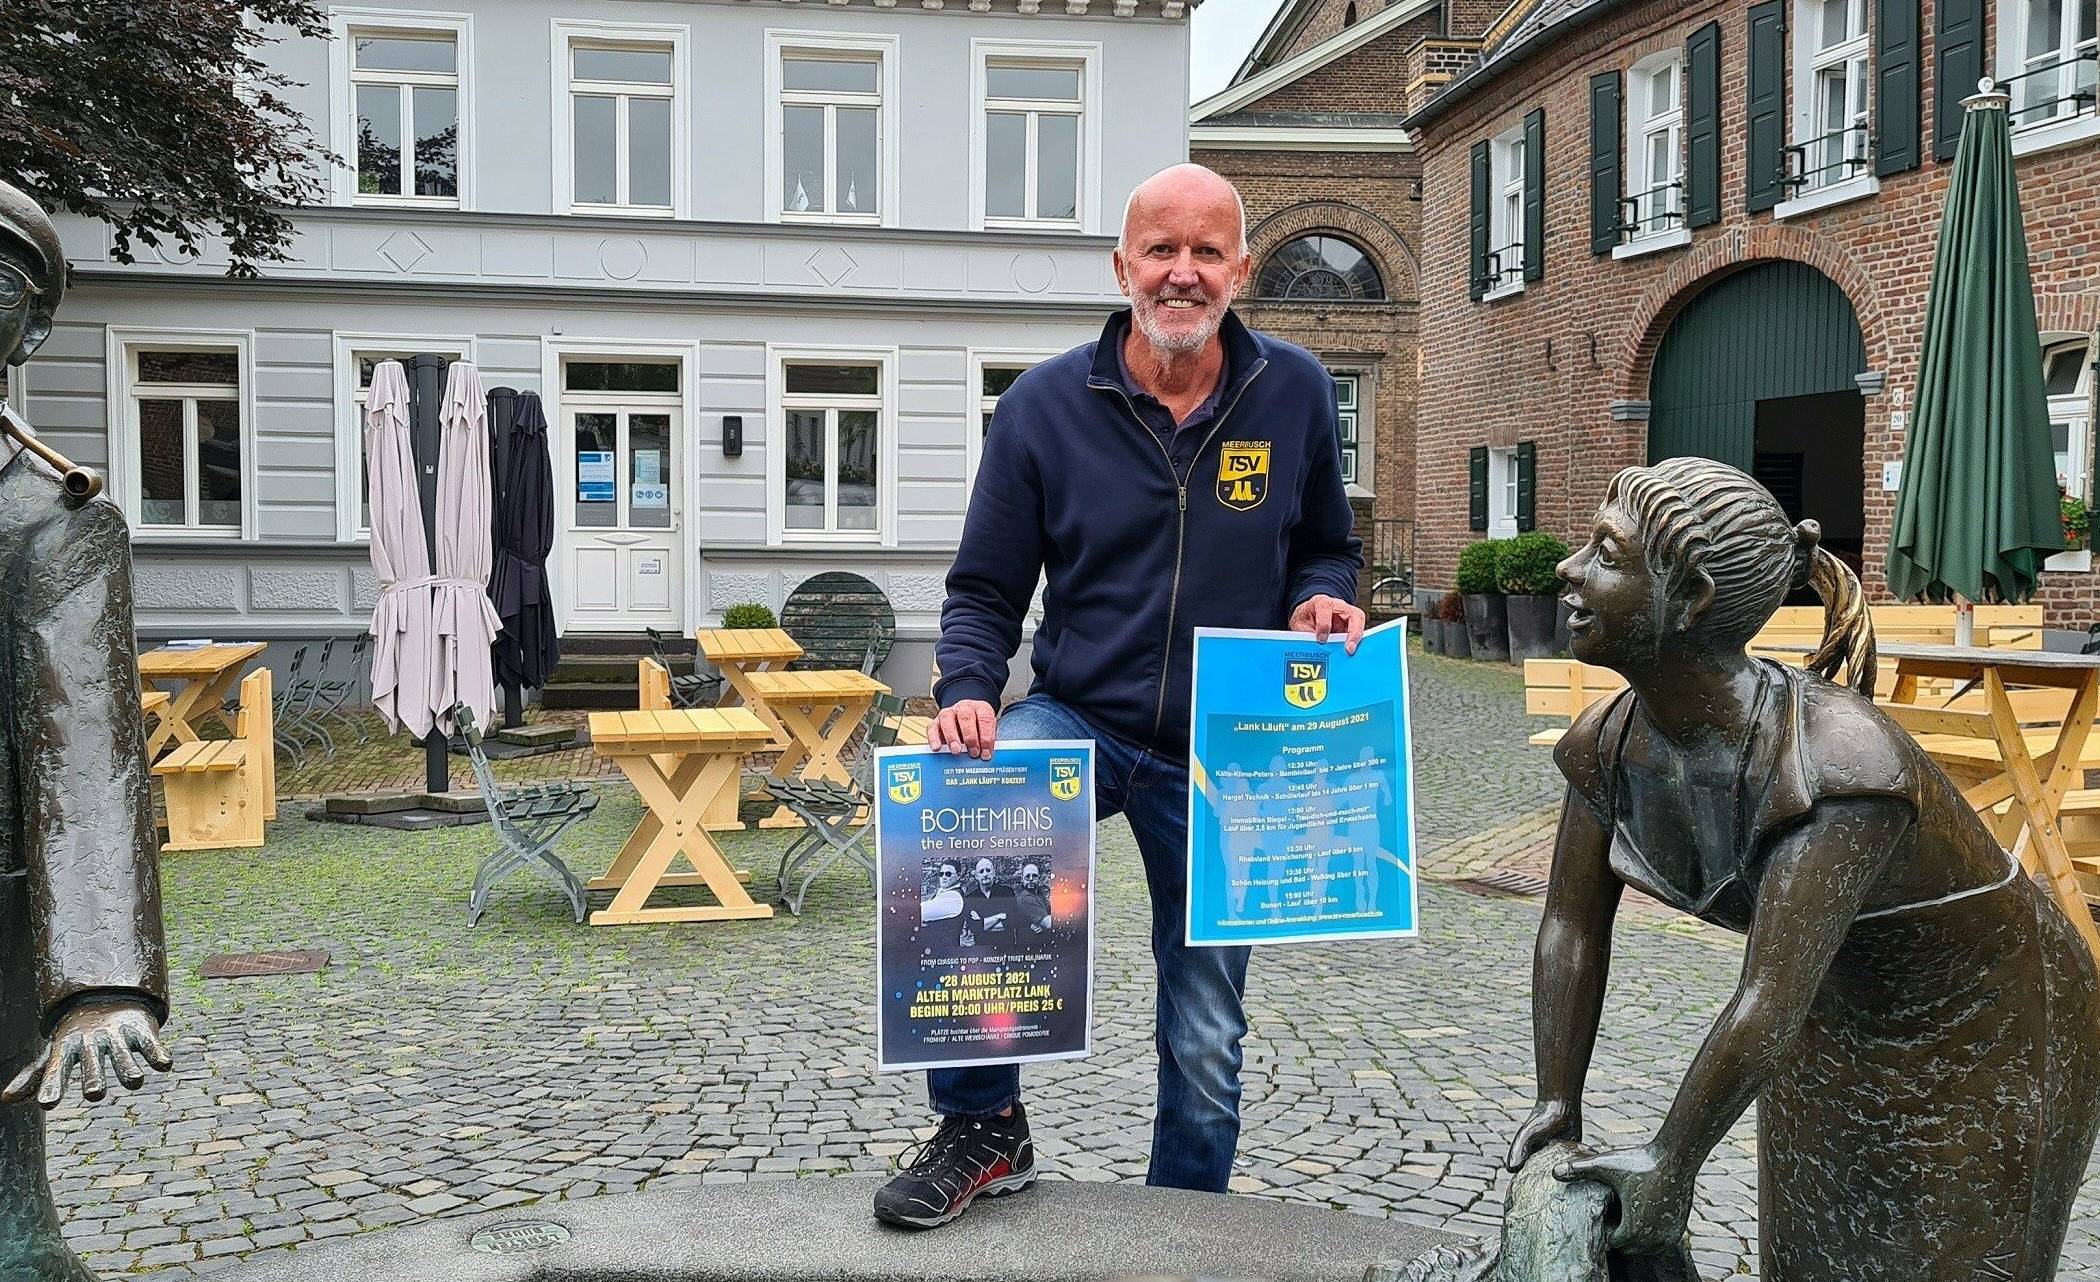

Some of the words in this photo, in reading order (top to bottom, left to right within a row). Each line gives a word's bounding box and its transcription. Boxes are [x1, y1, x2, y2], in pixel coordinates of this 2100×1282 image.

[1222, 440, 1271, 448] MEERBUSCH
[1229, 455, 1261, 472] TSV
[1284, 651, 1329, 660] MEERBUSCH
[1290, 663, 1321, 679] TSV
[1234, 721, 1260, 732] „Lank
[1261, 721, 1289, 732] Läuft“
[1291, 723, 1305, 731] am
[1307, 722, 1317, 731] 29
[1319, 717, 1350, 730] August
[1350, 712, 1369, 724] 2021
[1282, 744, 1324, 755] Programm
[1054, 766, 1076, 778] TSV
[1335, 763, 1352, 771] Jahre
[1353, 761, 1367, 769] über
[893, 771, 915, 782] TSV
[920, 806, 1053, 834] BOHEMIANS
[1224, 824, 1239, 832] Lauf
[1240, 824, 1254, 832] über
[920, 836, 943, 850] the
[948, 836, 985, 850] Tenor
[989, 835, 1053, 849] Sensation
[1238, 854, 1271, 863] Rheinland
[1272, 852, 1312, 862] Versicherung
[1318, 849, 1331, 857] Lauf
[1332, 847, 1346, 855] über
[1293, 875, 1306, 883] Bad
[1336, 870, 1351, 878] über
[1287, 899, 1301, 907] Lauf
[1303, 897, 1318, 905] über
[1319, 896, 1327, 904] 10
[920, 958, 936, 966] FROM
[960, 957, 967, 965] TO
[968, 956, 979, 964] POP
[960, 973, 1002, 986] AUGUST
[1005, 971, 1030, 985] 2021
[916, 989, 949, 1003] ALTER
[951, 986, 1021, 1002] MARKTPLATZ
[1024, 984, 1051, 998] LANK
[910, 1004, 949, 1018] BEGINN
[951, 1003, 981, 1016] 20:00
[1041, 999, 1054, 1012] 25
[1056, 998, 1063, 1011] €
